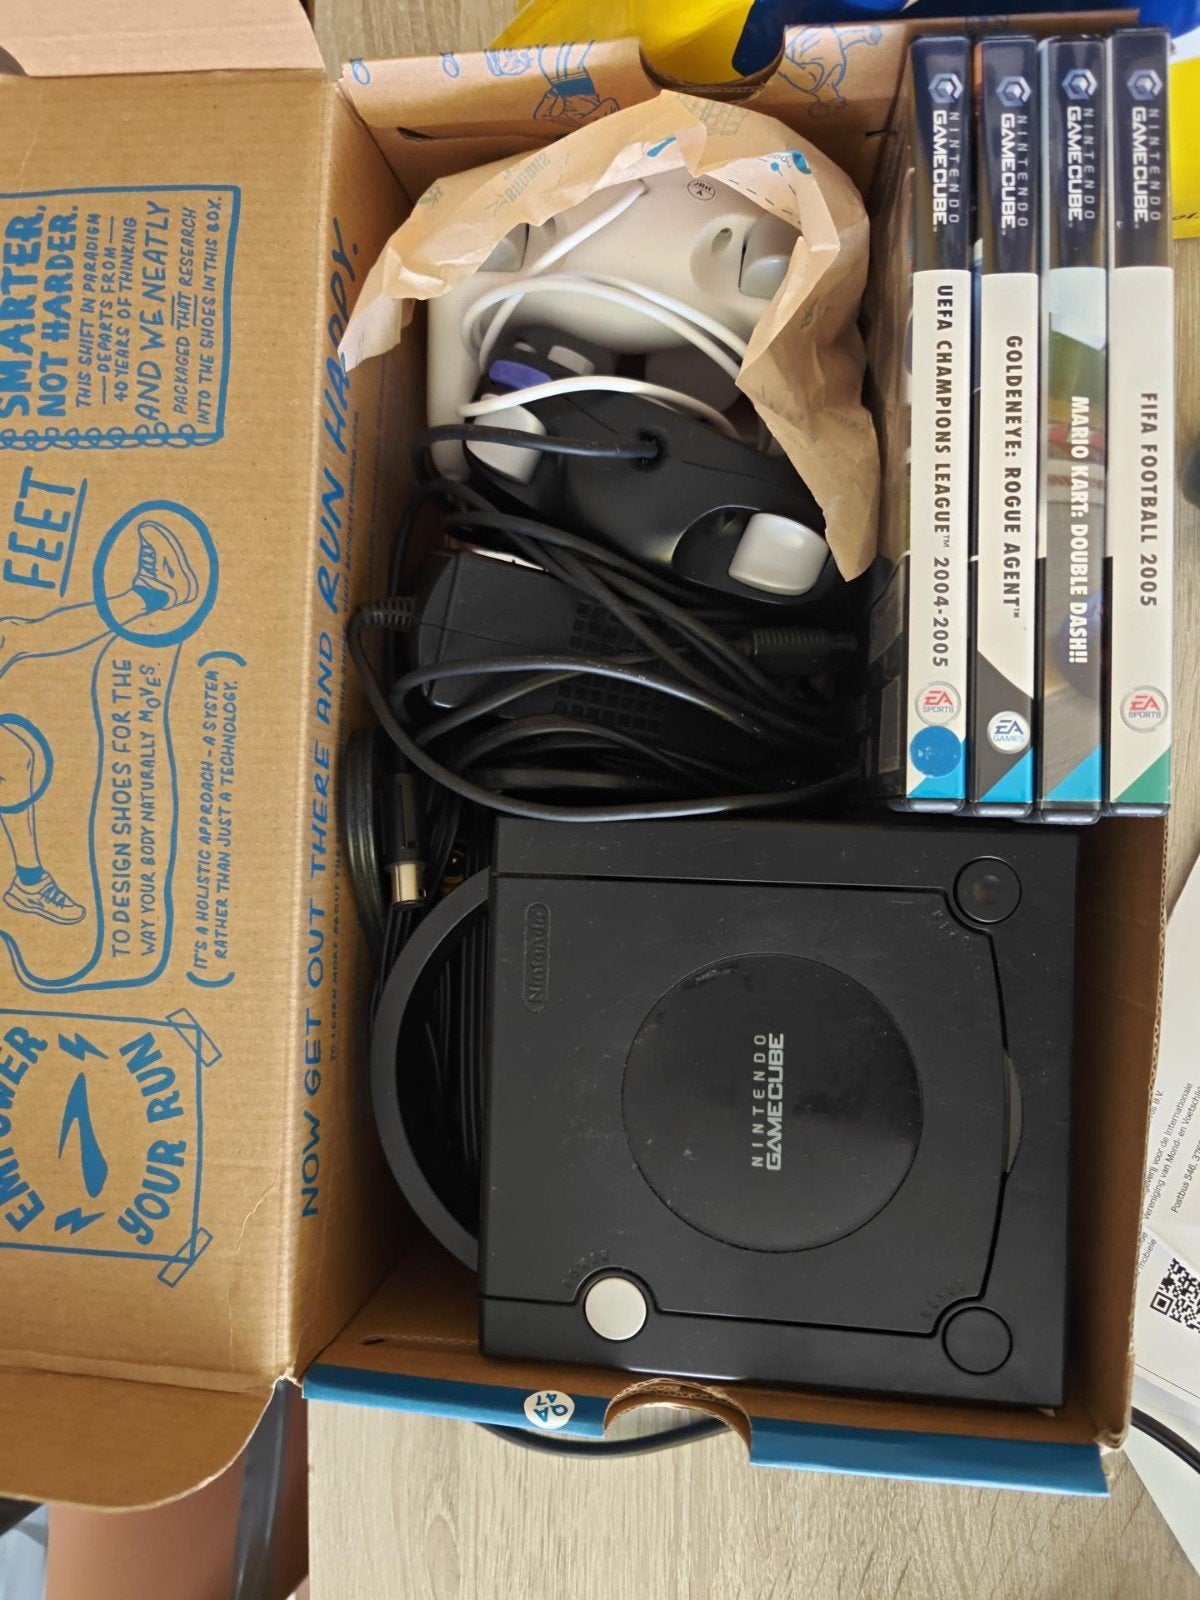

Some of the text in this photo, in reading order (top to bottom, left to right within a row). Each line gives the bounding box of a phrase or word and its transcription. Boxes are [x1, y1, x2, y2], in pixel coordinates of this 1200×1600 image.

[949, 112, 960, 224] NINTENDO
[1017, 115, 1028, 227] NINTENDO
[1084, 108, 1095, 220] NINTENDO
[1149, 108, 1160, 221] NINTENDO
[37, 205, 78, 417] NOT HARDER.
[76, 213, 101, 407] THIS SHIFT IN PARADIGM
[97, 247, 116, 373] DEPARTS FROM
[113, 217, 137, 402] 40 YEARS OF THINKING
[134, 200, 170, 421] AND WE NEATLY
[173, 206, 196, 415] PACKAGED THAT RESEARCH
[197, 196, 222, 425] INTO THE SHOES IN THIS BOX.
[936, 284, 953, 331] UEFA
[935, 340, 953, 453] CHAMPIONS
[1004, 335, 1023, 457] GOLDENEYE:
[3, 465, 76, 590] FEET
[1003, 467, 1022, 534] ROGUE
[1068, 396, 1090, 664] MARIO KART: DOUBLE DASH!!
[1139, 392, 1158, 607] FIFA FOOTBALL 2005
[932, 557, 950, 668] 2004-2005
[202, 670, 219, 731] SYSTEM
[202, 735, 216, 746] A
[301, 216, 359, 1218] NOW GET OUT THERE AND RUN HAPPY.
[922, 706, 955, 714] SPORTS
[924, 690, 954, 706] EA
[995, 720, 1024, 735] EA
[1128, 711, 1161, 719] SPORTS
[1129, 695, 1160, 710] EA
[111, 659, 132, 958] TO DESIGN SHOES FOR THE
[138, 662, 162, 956] WAY YOUR BODY NATURALLY MOVES.
[198, 760, 214, 845] APPROACH
[214, 680, 238, 959] RATHER THAN JUST A TECHNOLOGY.
[195, 926, 209, 935] A
[196, 849, 211, 922] HOLISTIC
[117, 1031, 187, 1246] YOUR RUN
[752, 1033, 766, 1168] NINTENDO
[766, 1033, 785, 1171] GAMECUBE
[1160, 1136, 1169, 1148] de
[1160, 1163, 1171, 1179] van
[1177, 1126, 1187, 1137] en
[1164, 1082, 1193, 1136] Internationale
[1170, 1180, 1190, 1213] Postbus
